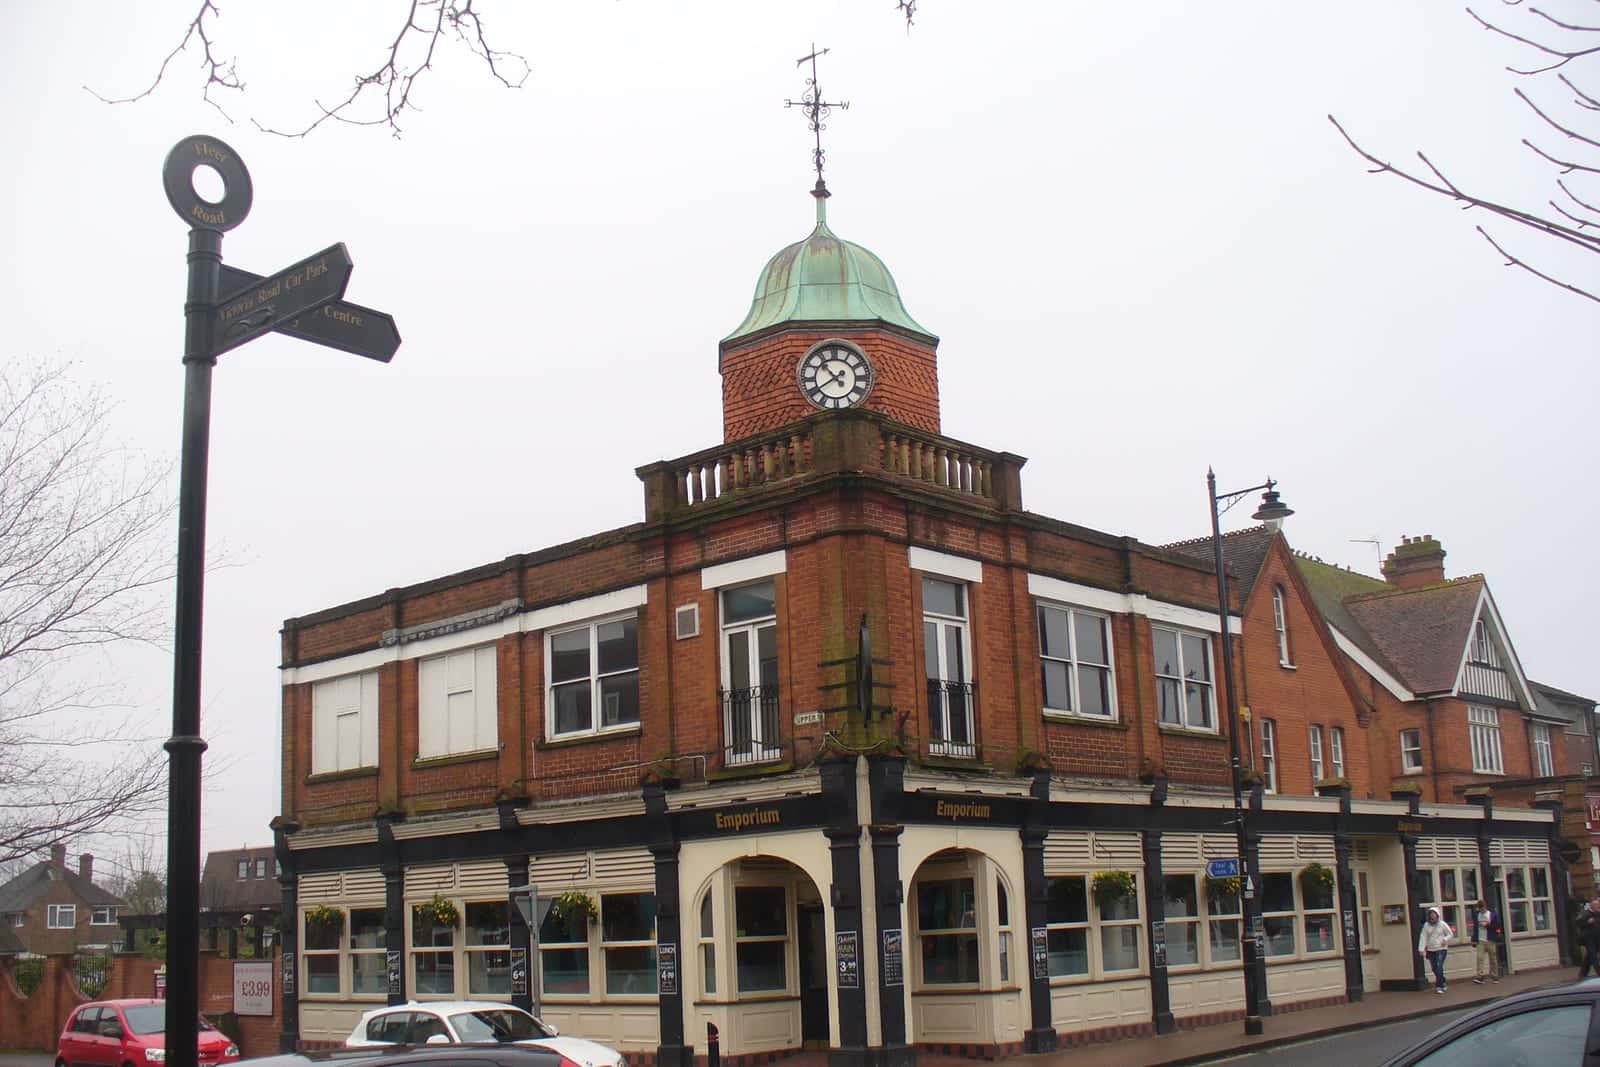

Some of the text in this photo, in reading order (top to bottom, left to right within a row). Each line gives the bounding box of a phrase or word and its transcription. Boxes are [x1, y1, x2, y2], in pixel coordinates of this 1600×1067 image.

[192, 207, 224, 224] Road
[286, 273, 306, 289] Car
[305, 259, 328, 280] Park
[322, 304, 362, 326] Centre
[716, 809, 780, 831] Emporium
[936, 800, 990, 821] Emporium
[241, 980, 270, 998] £3.99
